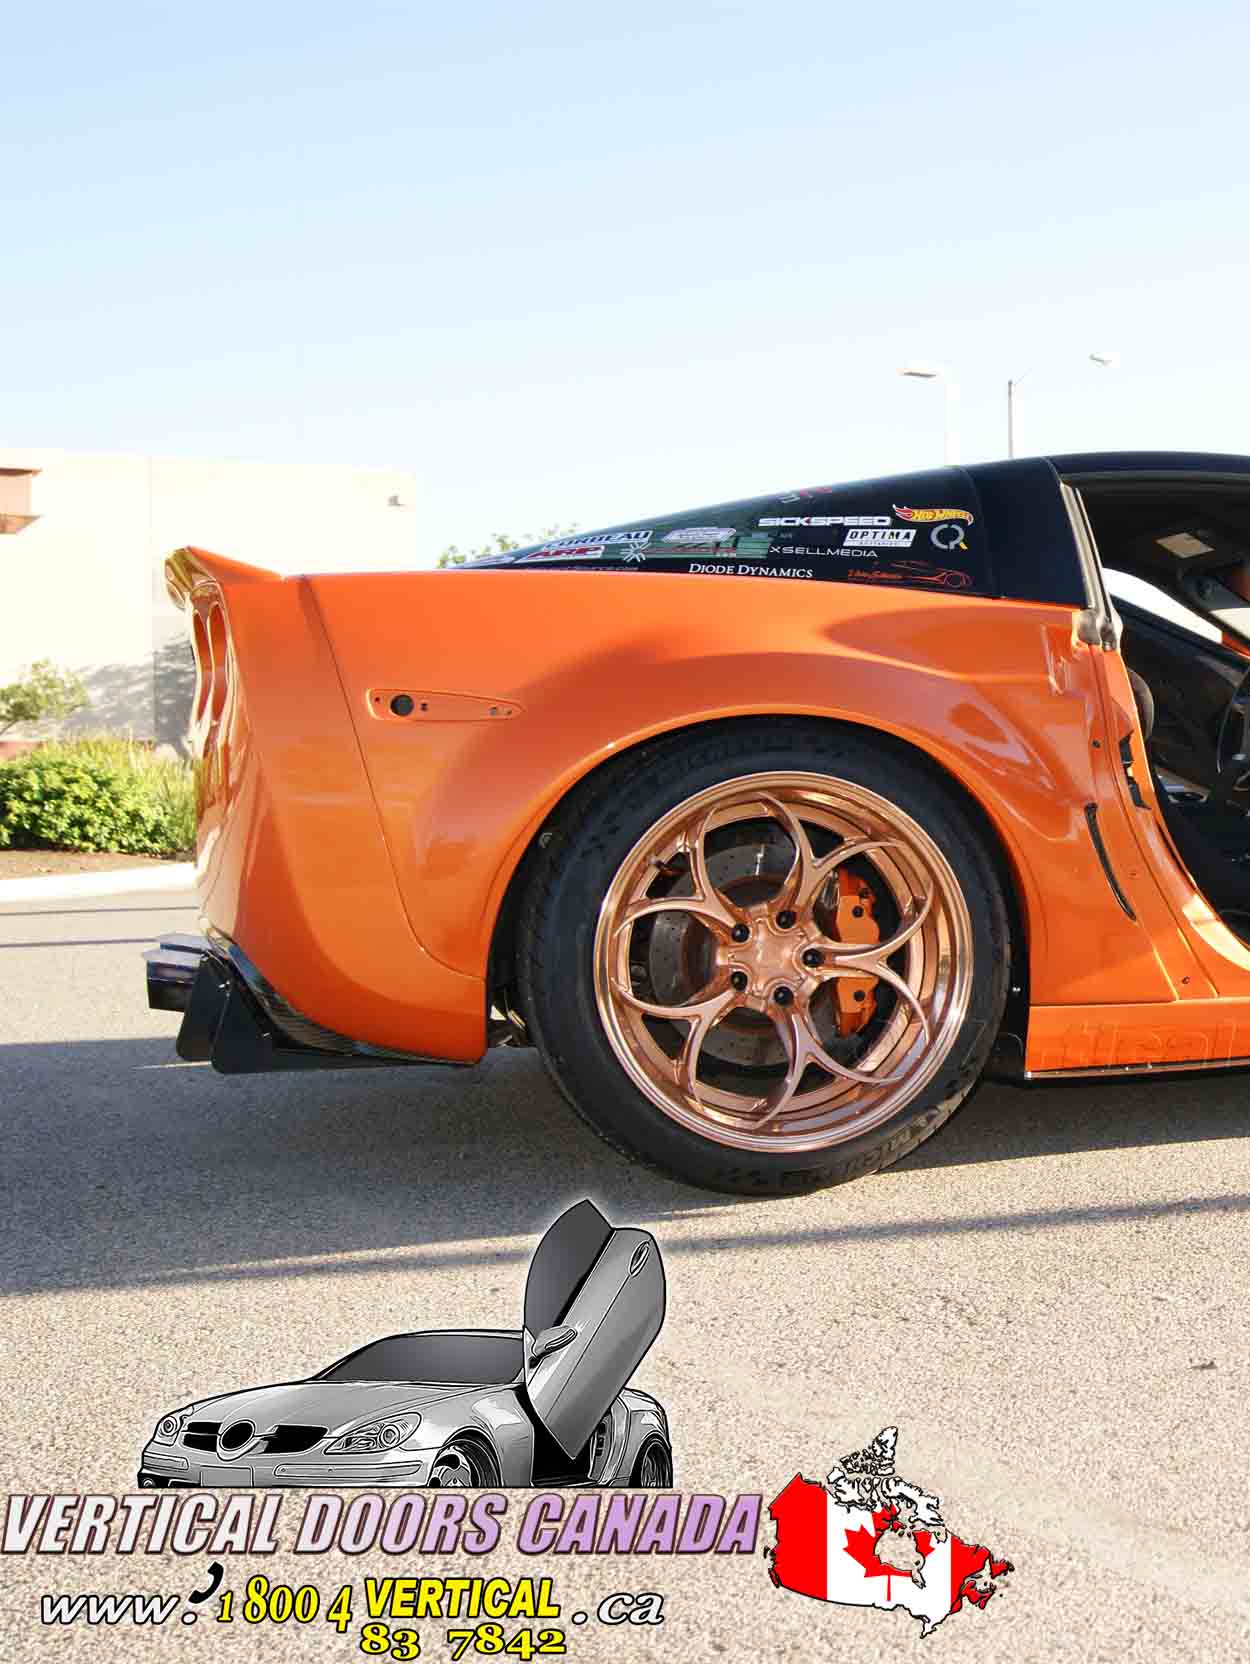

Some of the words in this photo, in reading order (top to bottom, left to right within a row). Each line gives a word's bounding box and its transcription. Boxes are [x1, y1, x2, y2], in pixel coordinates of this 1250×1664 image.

[758, 515, 892, 527] SICKSPEED
[848, 530, 912, 540] OPTIMA
[769, 545, 879, 558] XSELLMEDIA
[688, 562, 736, 575] DIODE
[737, 564, 814, 579] DYNAMICS
